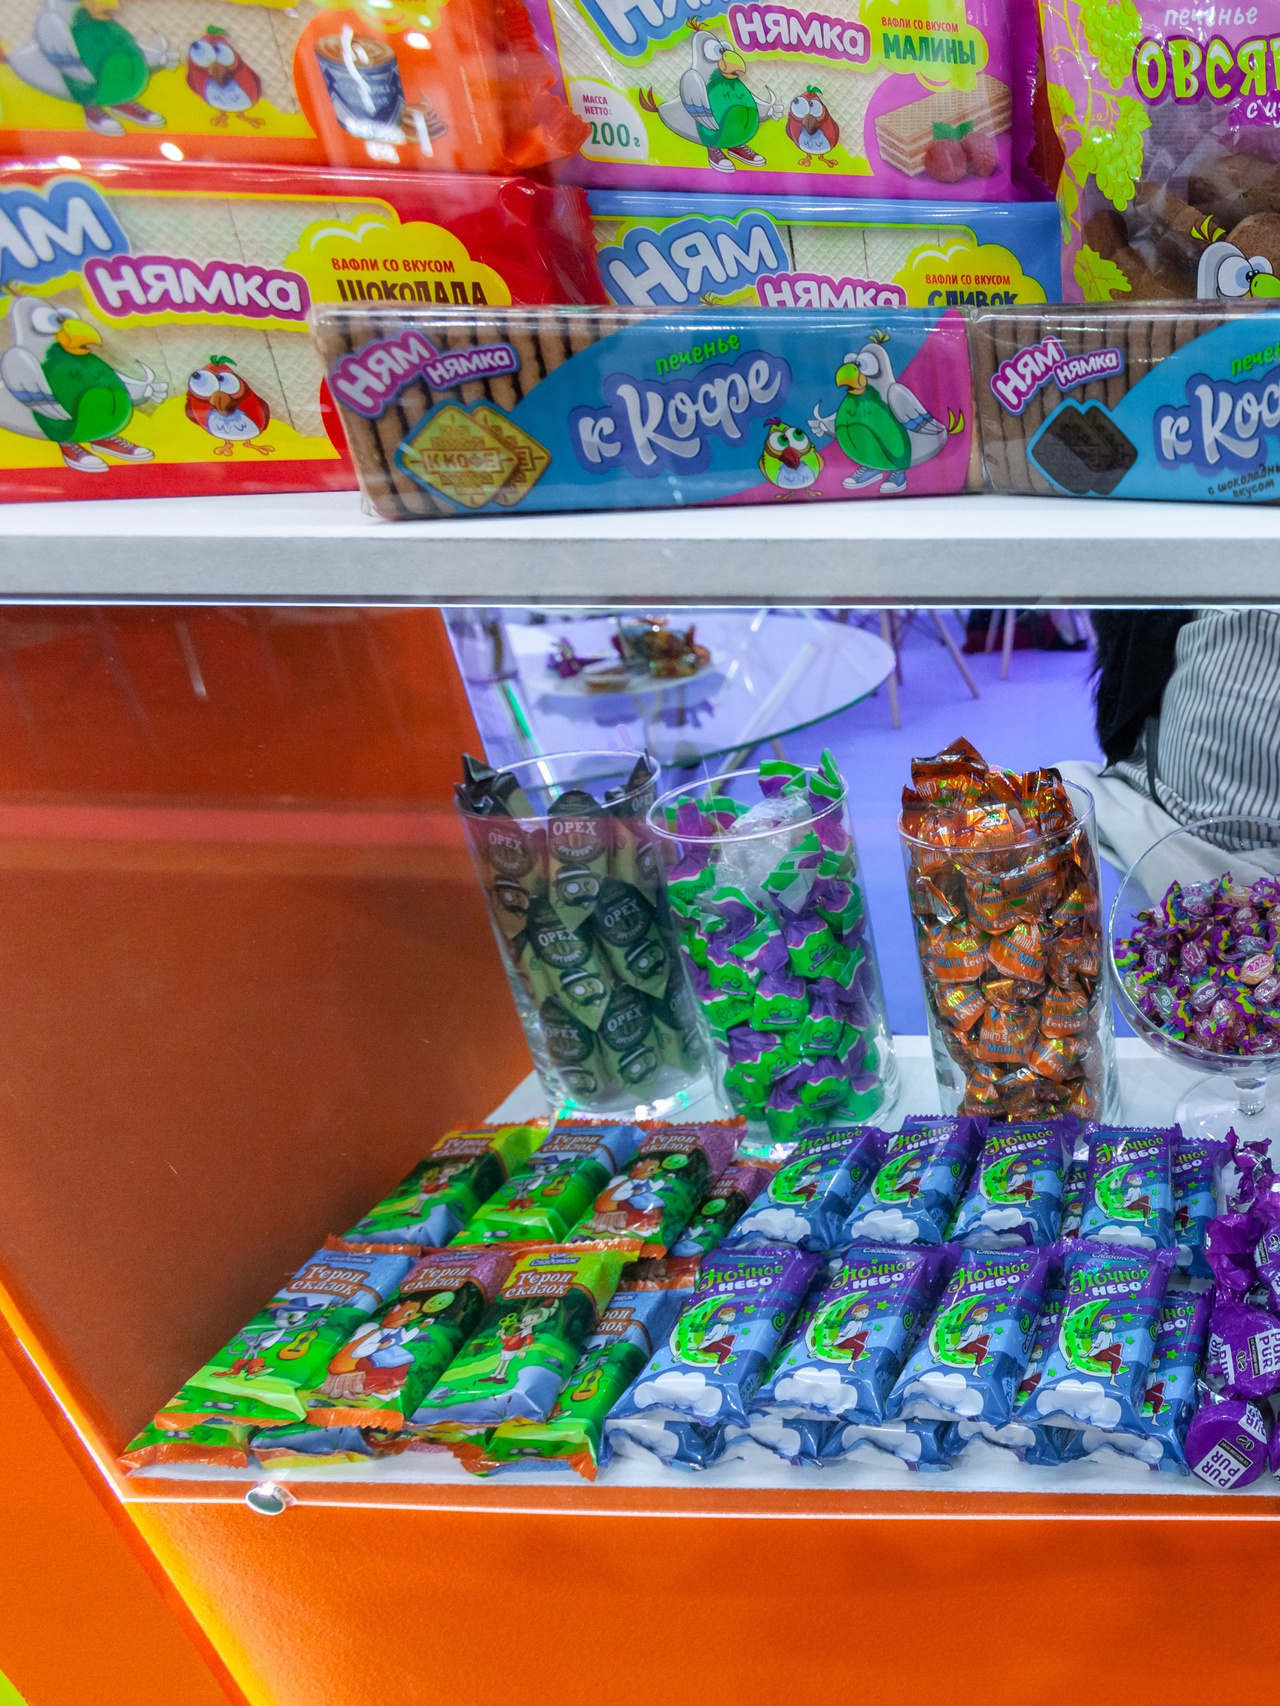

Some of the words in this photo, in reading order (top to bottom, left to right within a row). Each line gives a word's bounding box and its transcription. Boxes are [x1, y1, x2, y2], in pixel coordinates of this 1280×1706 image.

[913, 19, 924, 30] СО
[926, 20, 959, 33] ВКУСОМ
[883, 33, 976, 65] МАЛИНЫ
[331, 258, 379, 271] ВАФЛИ
[383, 259, 399, 272] СО
[402, 260, 455, 273] ВКУСОМ
[925, 274, 957, 285] ВАФЛИ
[960, 274, 972, 285] СО
[974, 274, 1011, 286] ВКУСОМ
[656, 334, 740, 375] печенье
[337, 336, 430, 408] НЯМ
[997, 340, 1061, 406] НЯМ
[305, 1266, 364, 1283] Герои
[516, 1271, 571, 1286] Герои
[695, 1264, 784, 1294] Ночное
[718, 1277, 773, 1292] НЕБО
[829, 1260, 915, 1290] Ночное
[852, 1273, 905, 1289] НЕБО
[947, 1263, 1030, 1294] Ночное
[969, 1275, 1020, 1293] НЕБО
[1068, 1267, 1149, 1296] Ночное
[290, 1280, 356, 1296] сказок
[505, 1284, 566, 1298] сказок
[1092, 1282, 1142, 1296] НЕБО
[1259, 1336, 1273, 1369] PUR
[1202, 1461, 1231, 1487] PUR
[1212, 1451, 1241, 1476] PUR
